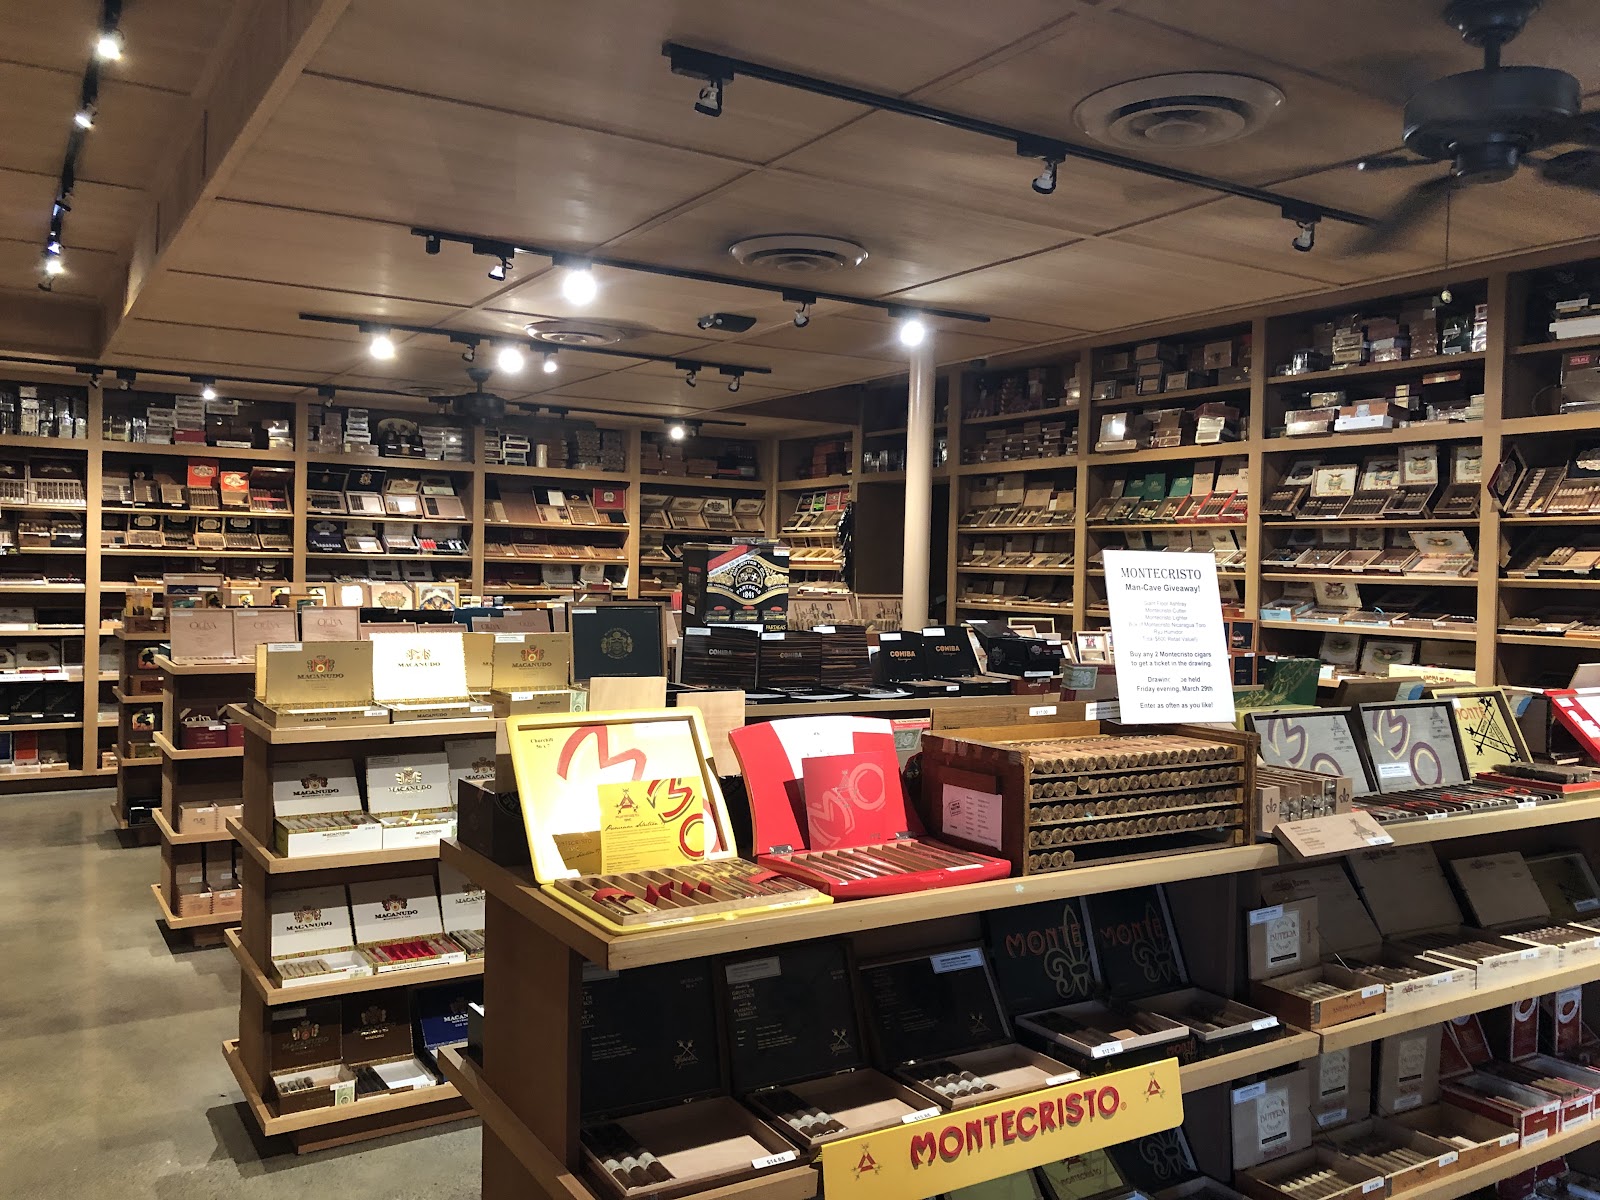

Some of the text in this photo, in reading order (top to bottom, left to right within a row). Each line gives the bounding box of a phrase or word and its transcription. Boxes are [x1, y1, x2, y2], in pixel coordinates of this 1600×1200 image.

[1121, 567, 1202, 580] MONTECRISTO
[1125, 583, 1201, 594] Man-Cave Giveaway!
[708, 648, 732, 656] COHIBA
[890, 650, 916, 658] COHIBA
[1130, 650, 1142, 658] Buy
[1138, 660, 1148, 668] get
[1136, 685, 1155, 693] Friday
[293, 788, 340, 797] MACANUDO
[388, 784, 432, 793] MACANUDO
[374, 909, 418, 920] MACANUDO
[286, 920, 332, 931] MACANUDO
[1006, 923, 1084, 958] MONTE
[910, 1085, 1120, 1170] MONTECRISTO
